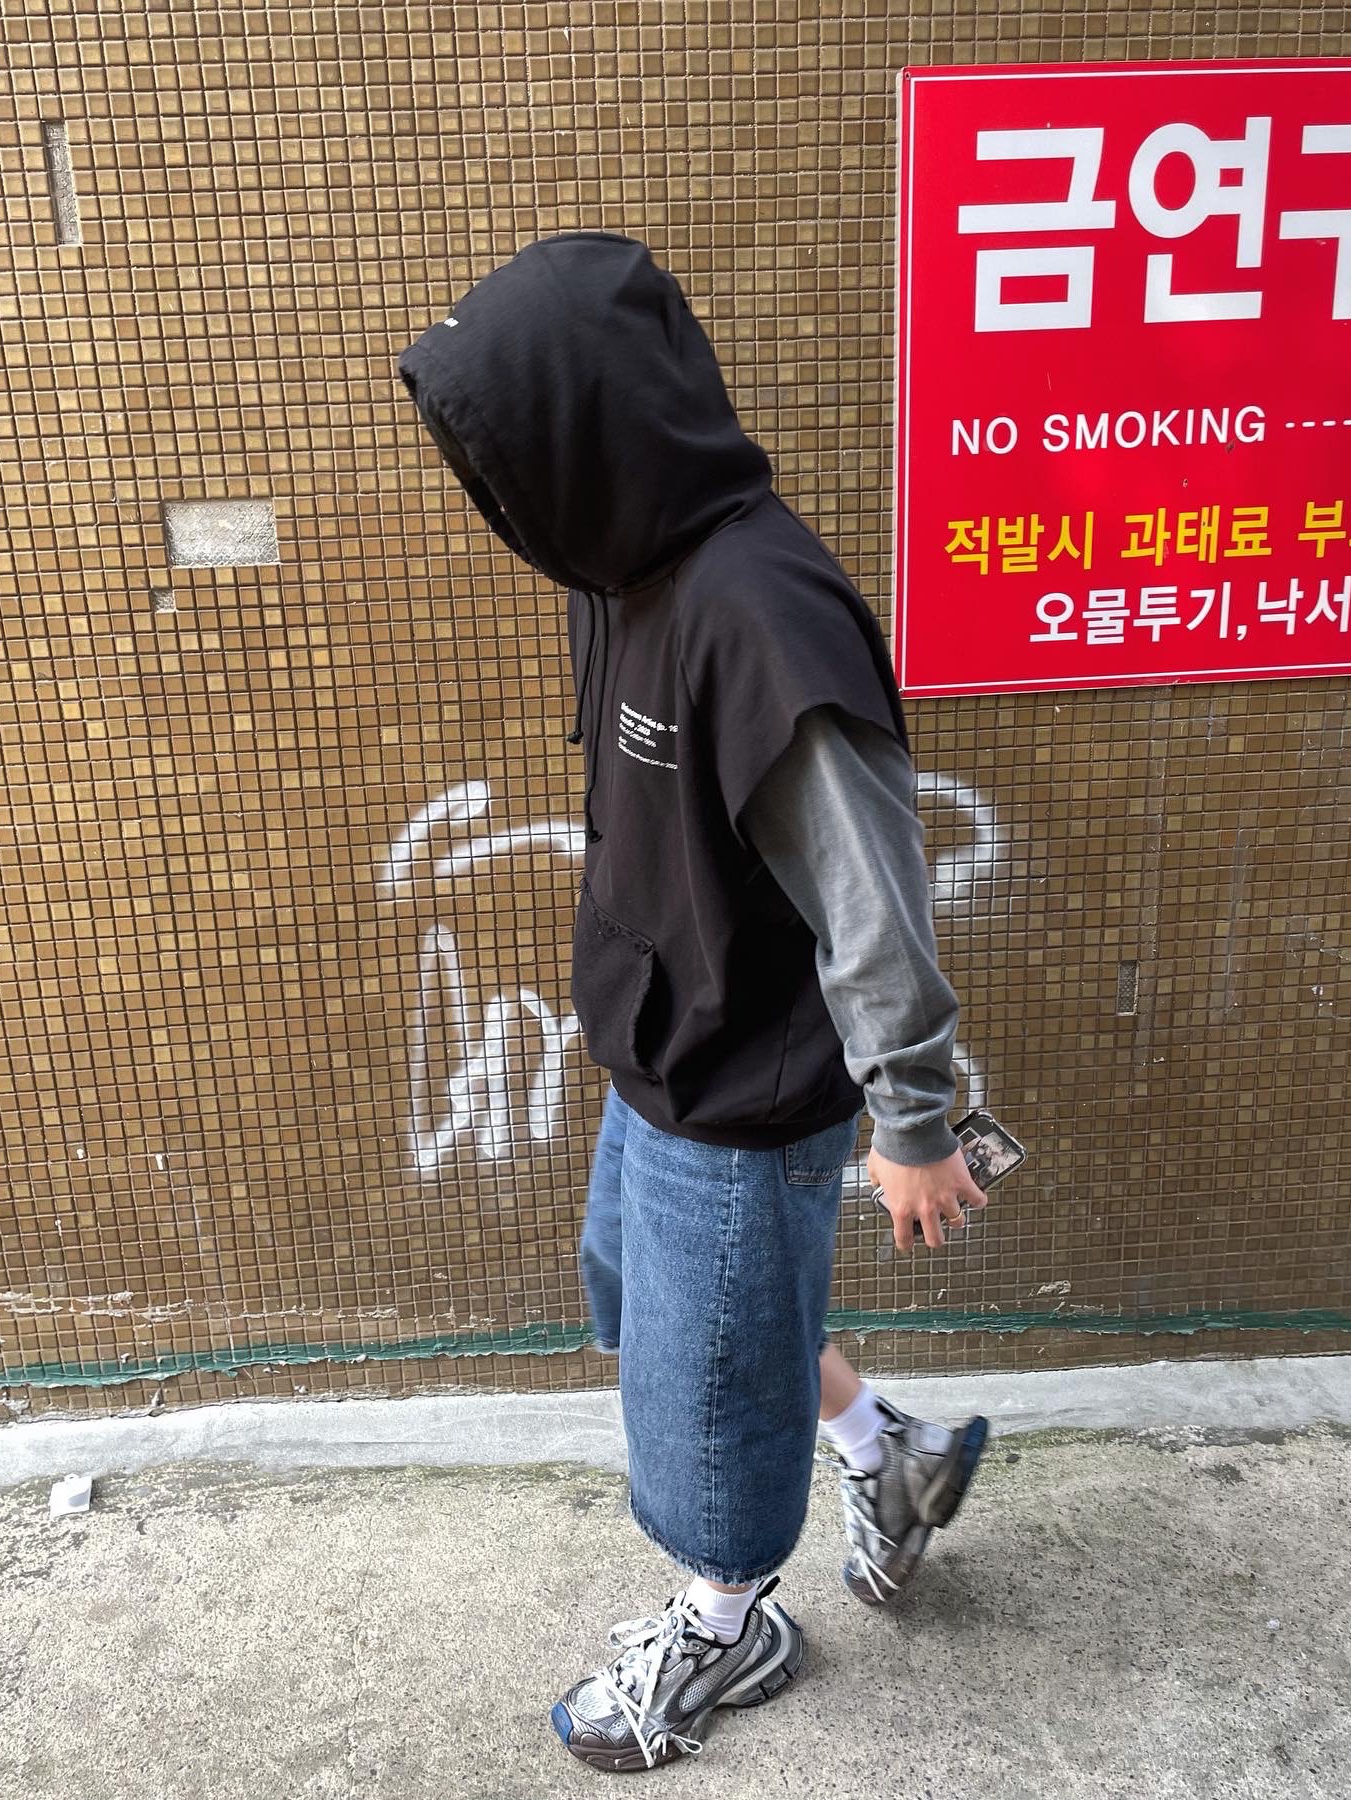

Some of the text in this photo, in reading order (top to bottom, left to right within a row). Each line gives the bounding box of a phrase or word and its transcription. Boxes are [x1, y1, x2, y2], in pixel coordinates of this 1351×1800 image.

[953, 406, 1265, 455] NO SMOKING
[945, 501, 1351, 575] 적발시 과태료 부
